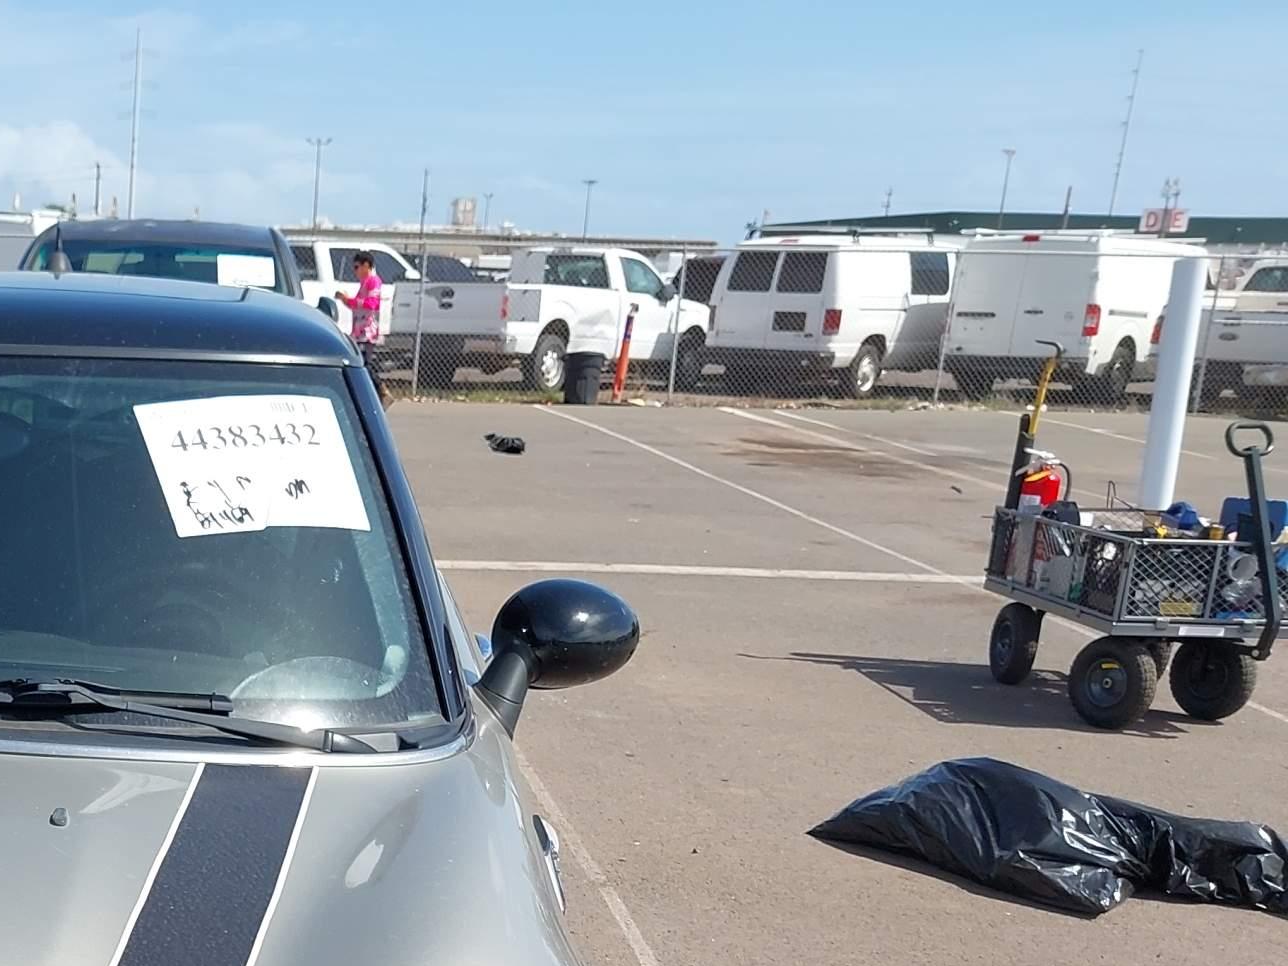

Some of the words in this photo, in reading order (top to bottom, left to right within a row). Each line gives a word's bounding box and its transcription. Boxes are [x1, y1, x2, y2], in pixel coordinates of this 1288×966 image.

[1145, 211, 1158, 229] D
[1172, 211, 1185, 229] E
[170, 423, 321, 452] 44383432
